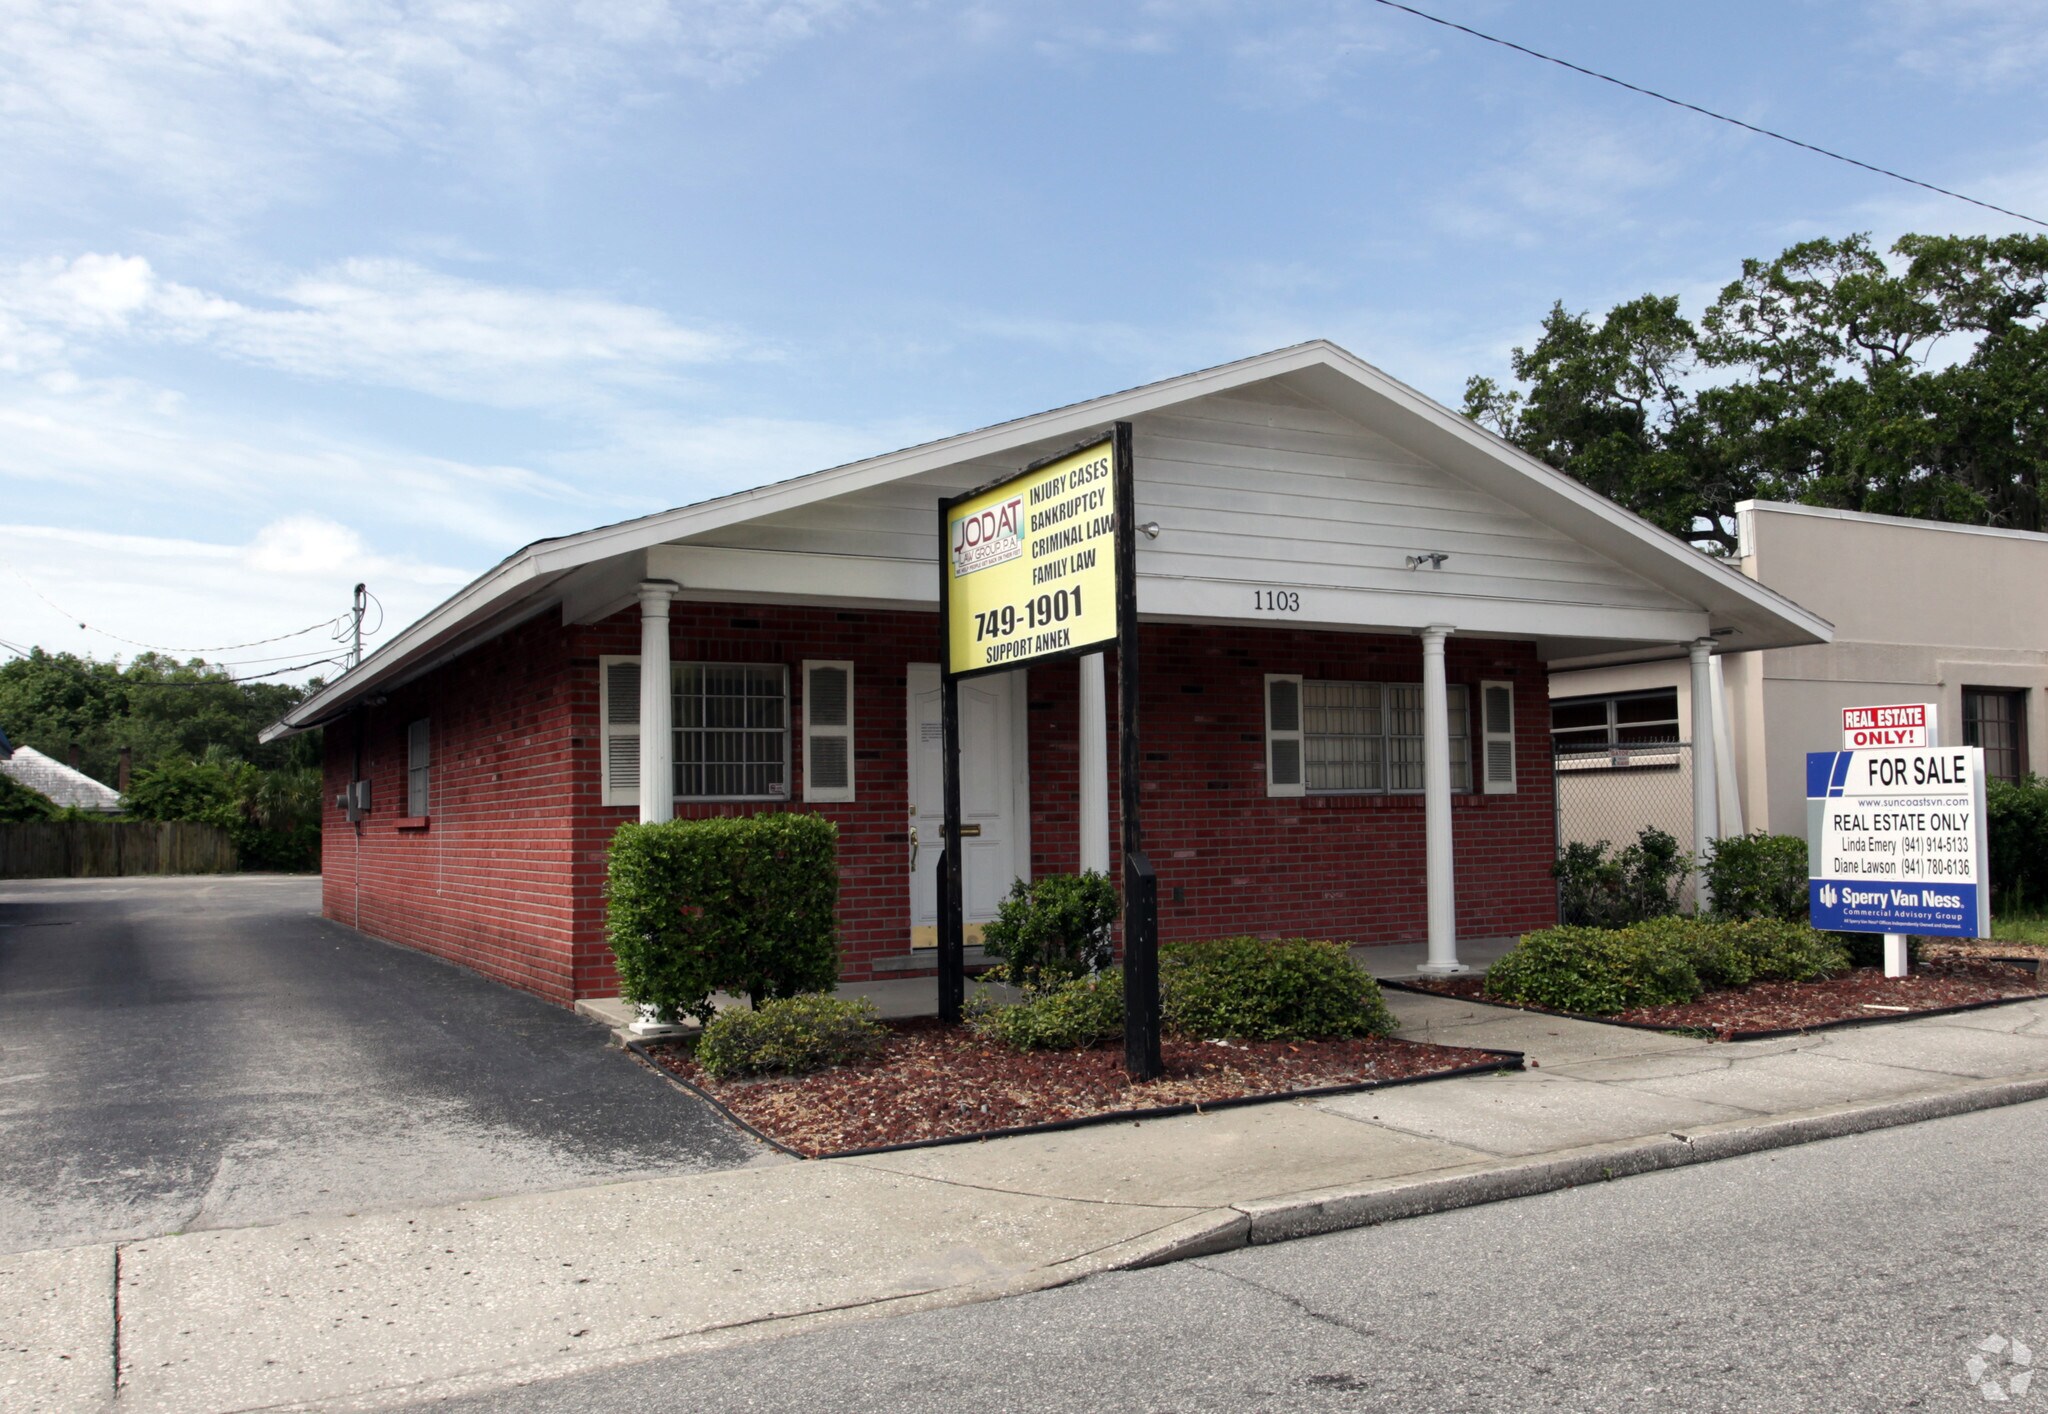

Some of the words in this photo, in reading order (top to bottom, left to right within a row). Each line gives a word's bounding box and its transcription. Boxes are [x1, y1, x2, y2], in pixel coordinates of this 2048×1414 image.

[1030, 474, 1066, 506] INJURY
[1069, 458, 1108, 489] CASES
[1031, 487, 1105, 532] BANKRUPTCY
[954, 499, 1021, 552] JODAT
[1031, 524, 1083, 559] CRIMINAL
[1086, 513, 1115, 540] LAW
[959, 550, 974, 564] LAW
[1032, 557, 1067, 586] FAMILY
[1070, 548, 1096, 573] LAW
[1254, 590, 1300, 612] 1103
[975, 585, 1082, 642] 749-1901
[986, 636, 1033, 664] SUPPORT
[1035, 628, 1070, 653] ANNEX
[1845, 710, 1875, 728] REAL
[1877, 707, 1923, 727] ESTATE
[1853, 730, 1914, 746] ONLY!
[1868, 758, 1908, 786] FOR
[1913, 755, 1966, 785] SALE
[1858, 797, 1969, 807] www.suncoastsvn.com
[1834, 814, 1869, 831] REAL
[1874, 813, 1926, 831] ESTATE
[1930, 813, 1969, 831] ONLY
[1842, 837, 1866, 852] Linda
[1868, 836, 1896, 856] Emery
[1901, 837, 1924, 856] (941)
[1926, 837, 1968, 852] 914-5133
[1834, 858, 1859, 873] Diane
[1861, 858, 1896, 874] Lawson
[1901, 859, 1924, 879] (941)
[1927, 859, 1970, 875] 780-6136
[1842, 887, 1888, 909] Sperry
[1890, 889, 1919, 907] Van
[1843, 908, 1891, 917] Commercial
[1894, 910, 1932, 920] Advisory
[1935, 912, 1963, 921] Group
